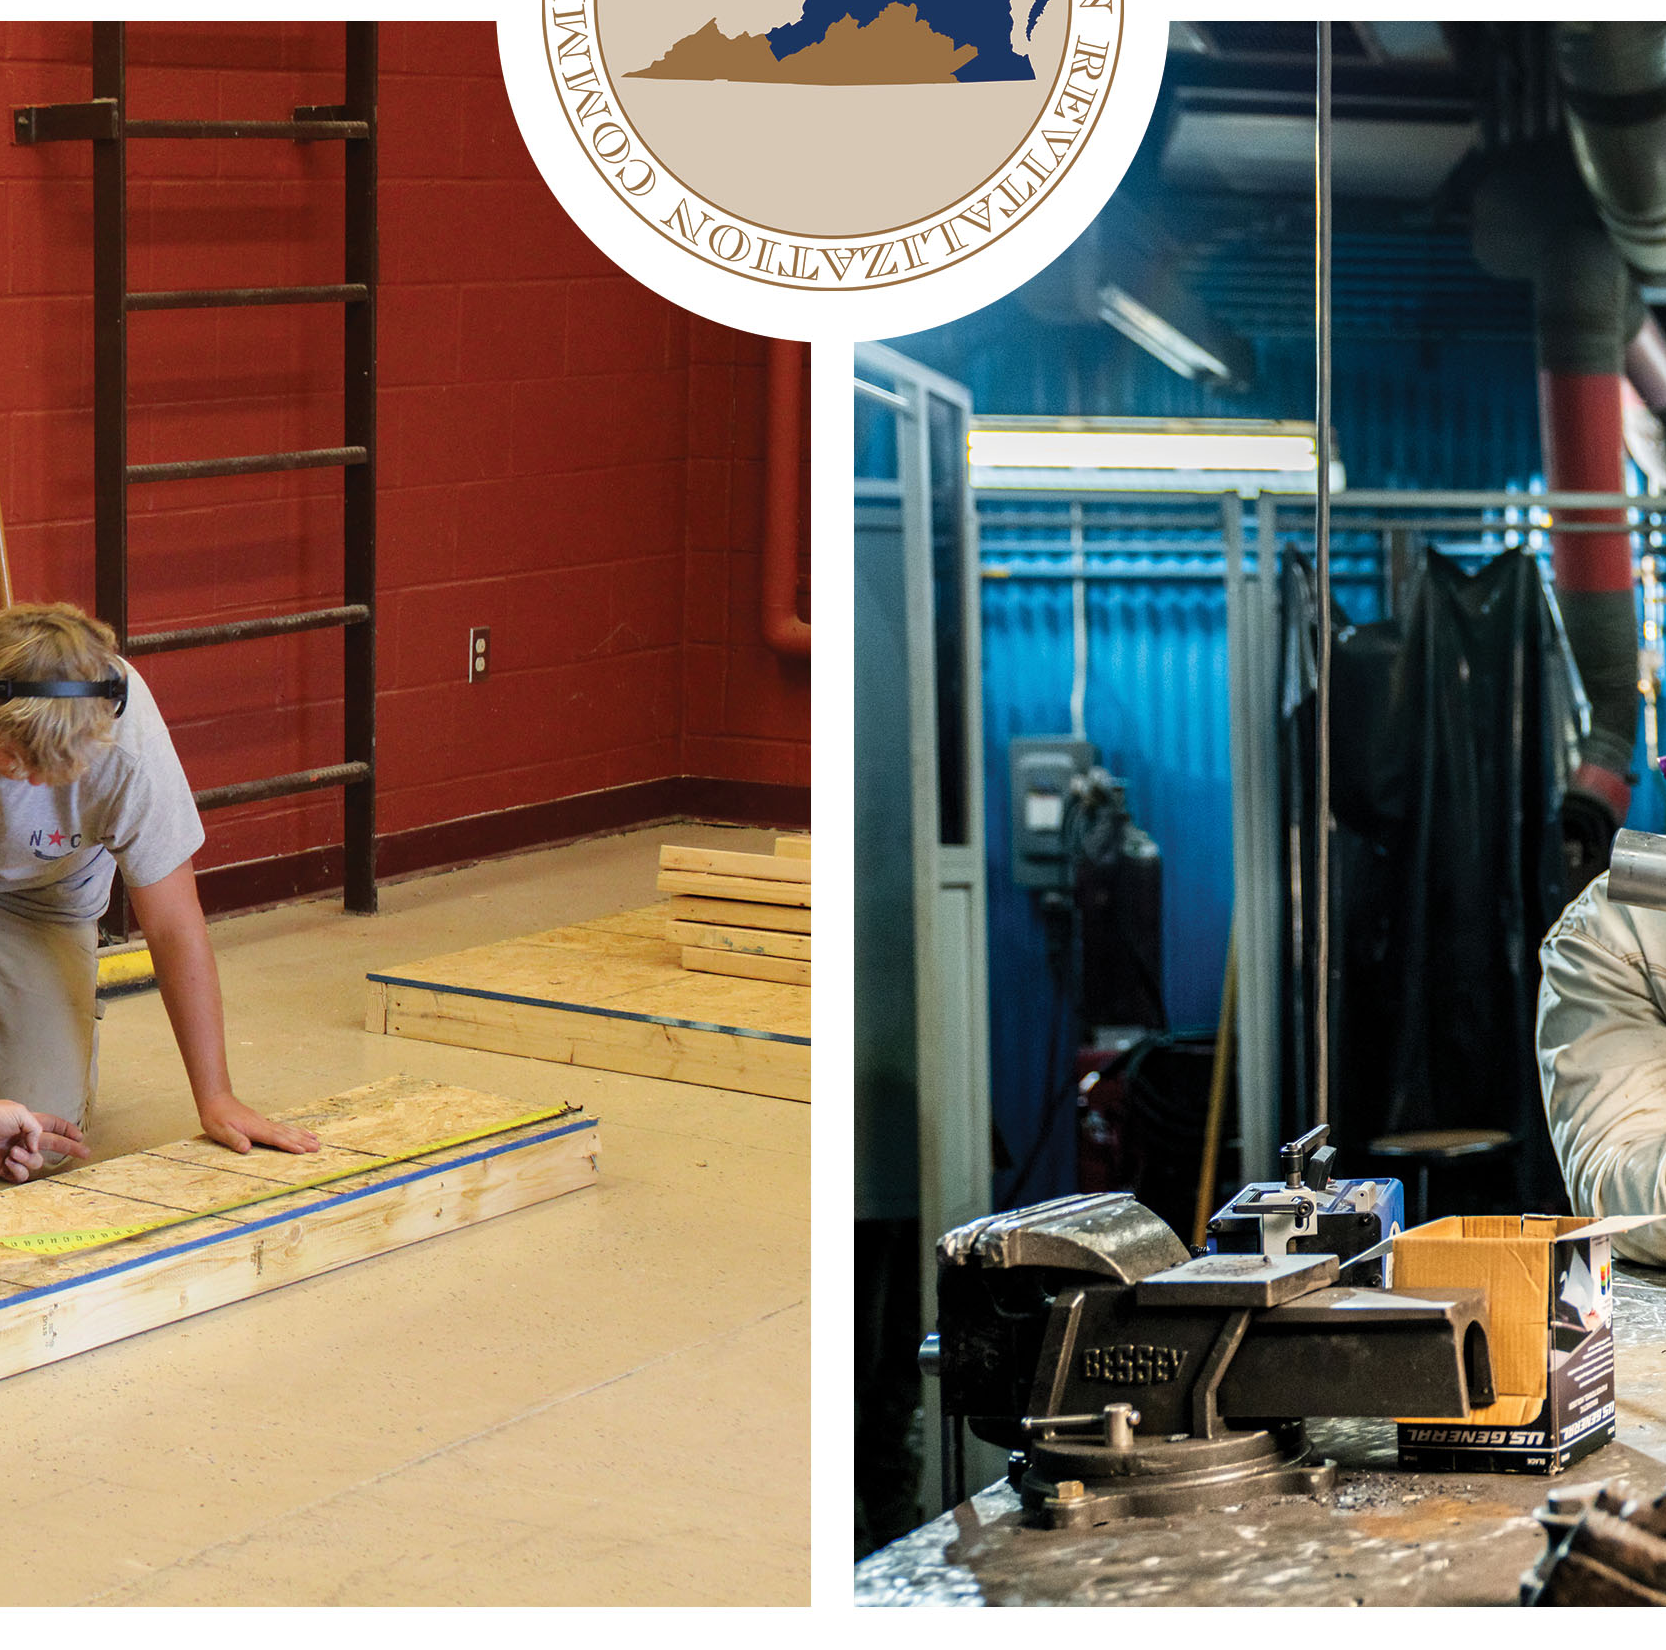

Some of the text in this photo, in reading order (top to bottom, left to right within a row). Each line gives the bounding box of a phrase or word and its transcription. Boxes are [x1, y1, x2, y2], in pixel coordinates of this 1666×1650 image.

[29, 829, 82, 849] N C
[1084, 1344, 1189, 1386] BESSEY
[1406, 1429, 1505, 1445] GENERAL
